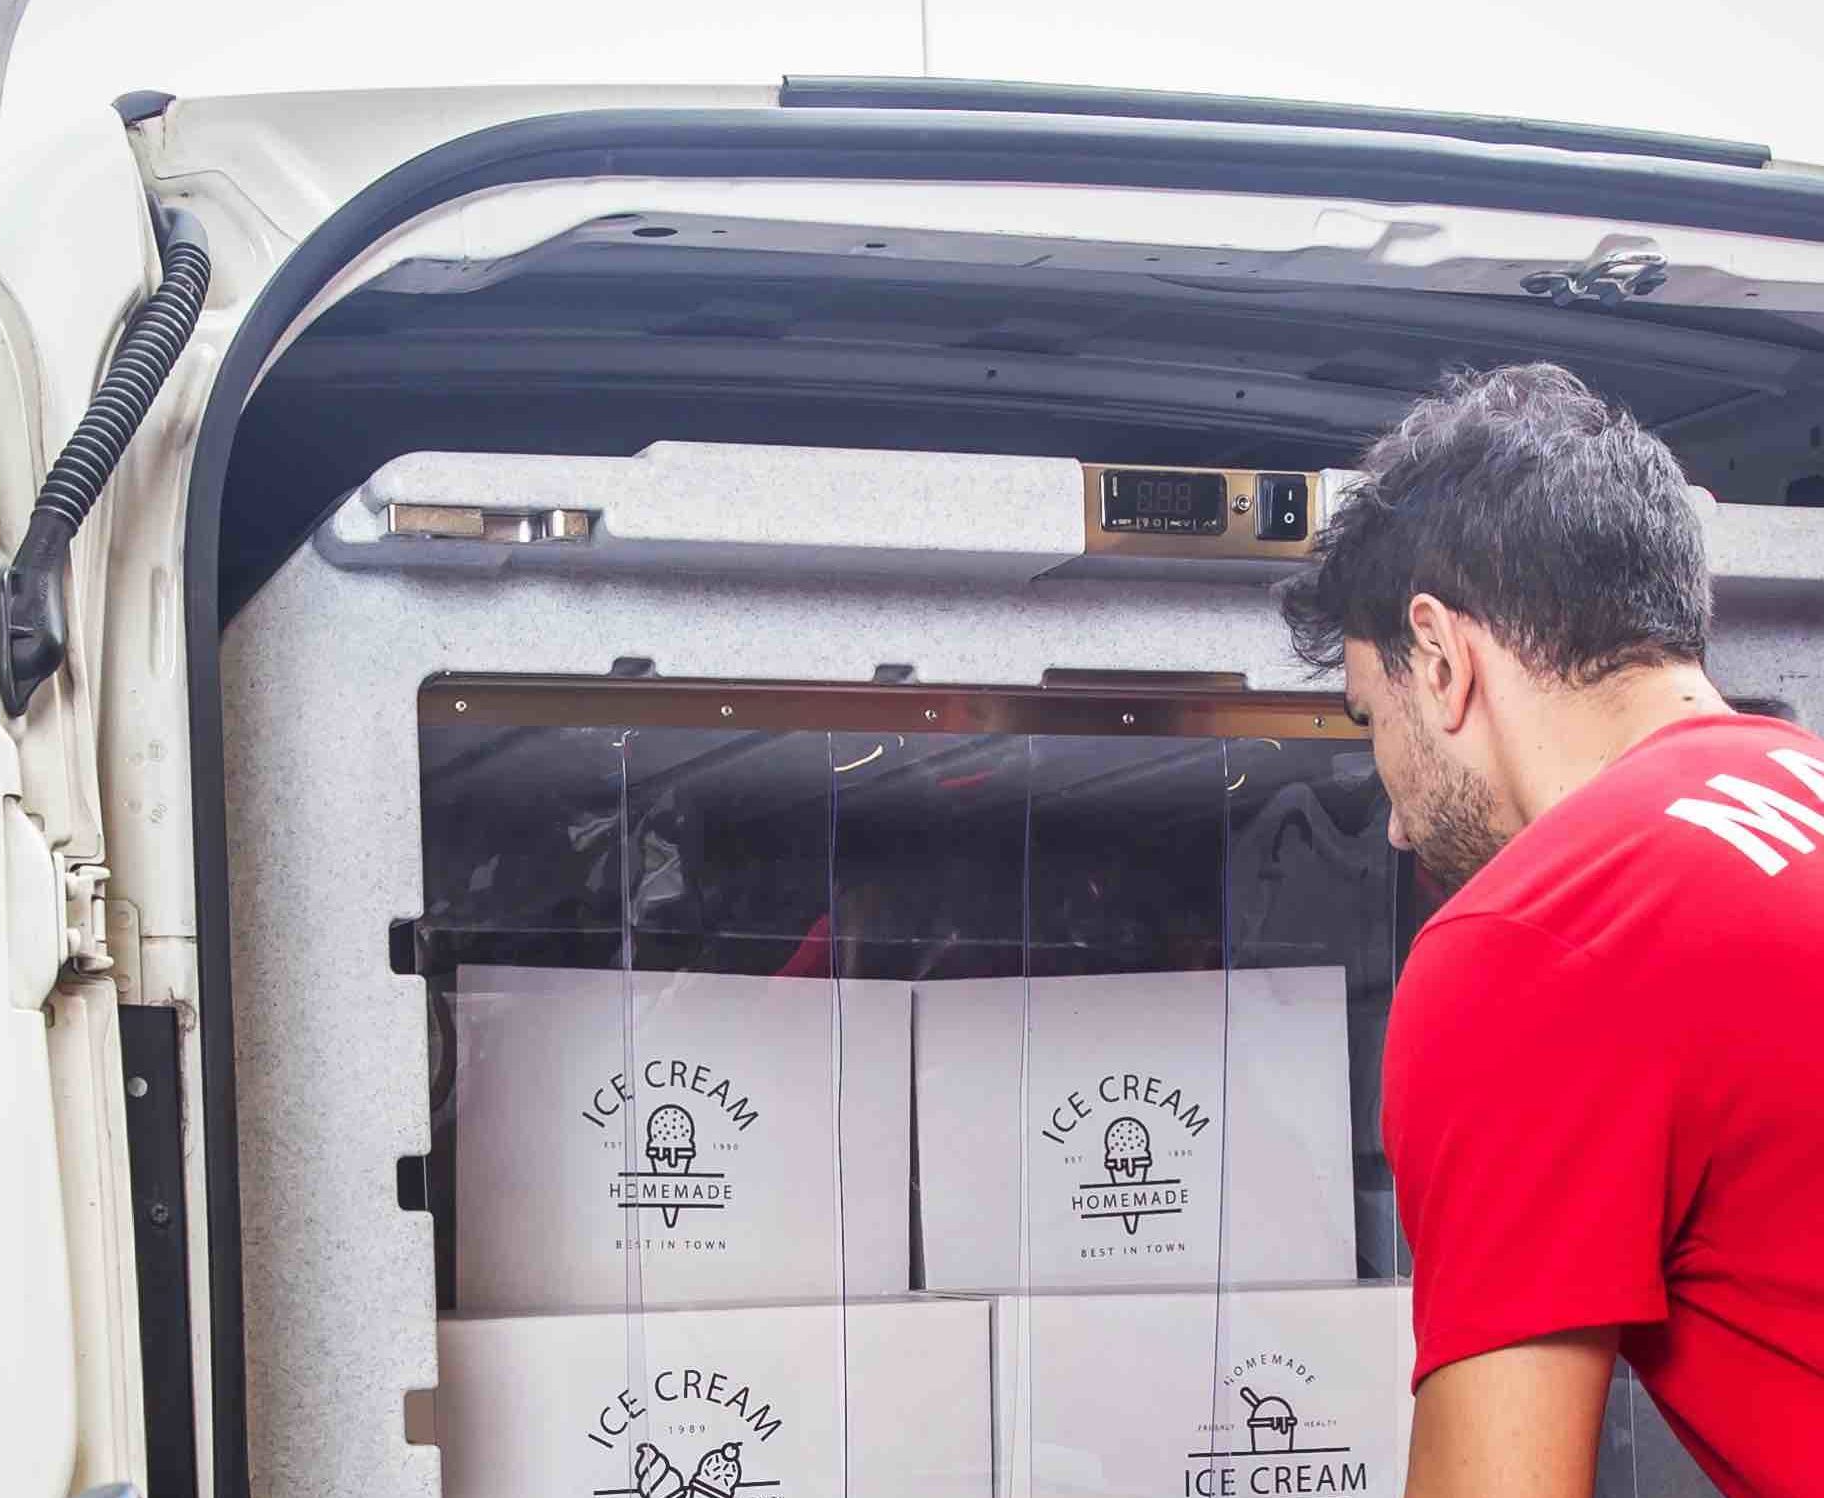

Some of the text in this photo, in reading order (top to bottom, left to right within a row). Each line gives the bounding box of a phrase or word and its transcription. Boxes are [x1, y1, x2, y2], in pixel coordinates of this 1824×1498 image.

[582, 1060, 759, 1131] ICE CREAM
[1042, 1074, 1210, 1144] ICE CREAM
[609, 1183, 733, 1200] HOMEMADE
[1072, 1189, 1190, 1211] HOMEMADE
[661, 1239, 675, 1250] IN
[685, 1239, 727, 1250] TOWN
[1081, 1243, 1185, 1259] BEST IN TOWN
[588, 1369, 782, 1449] ICE CREAM
[669, 1425, 706, 1434] 1989
[1184, 1463, 1368, 1497] ICE CREAM
